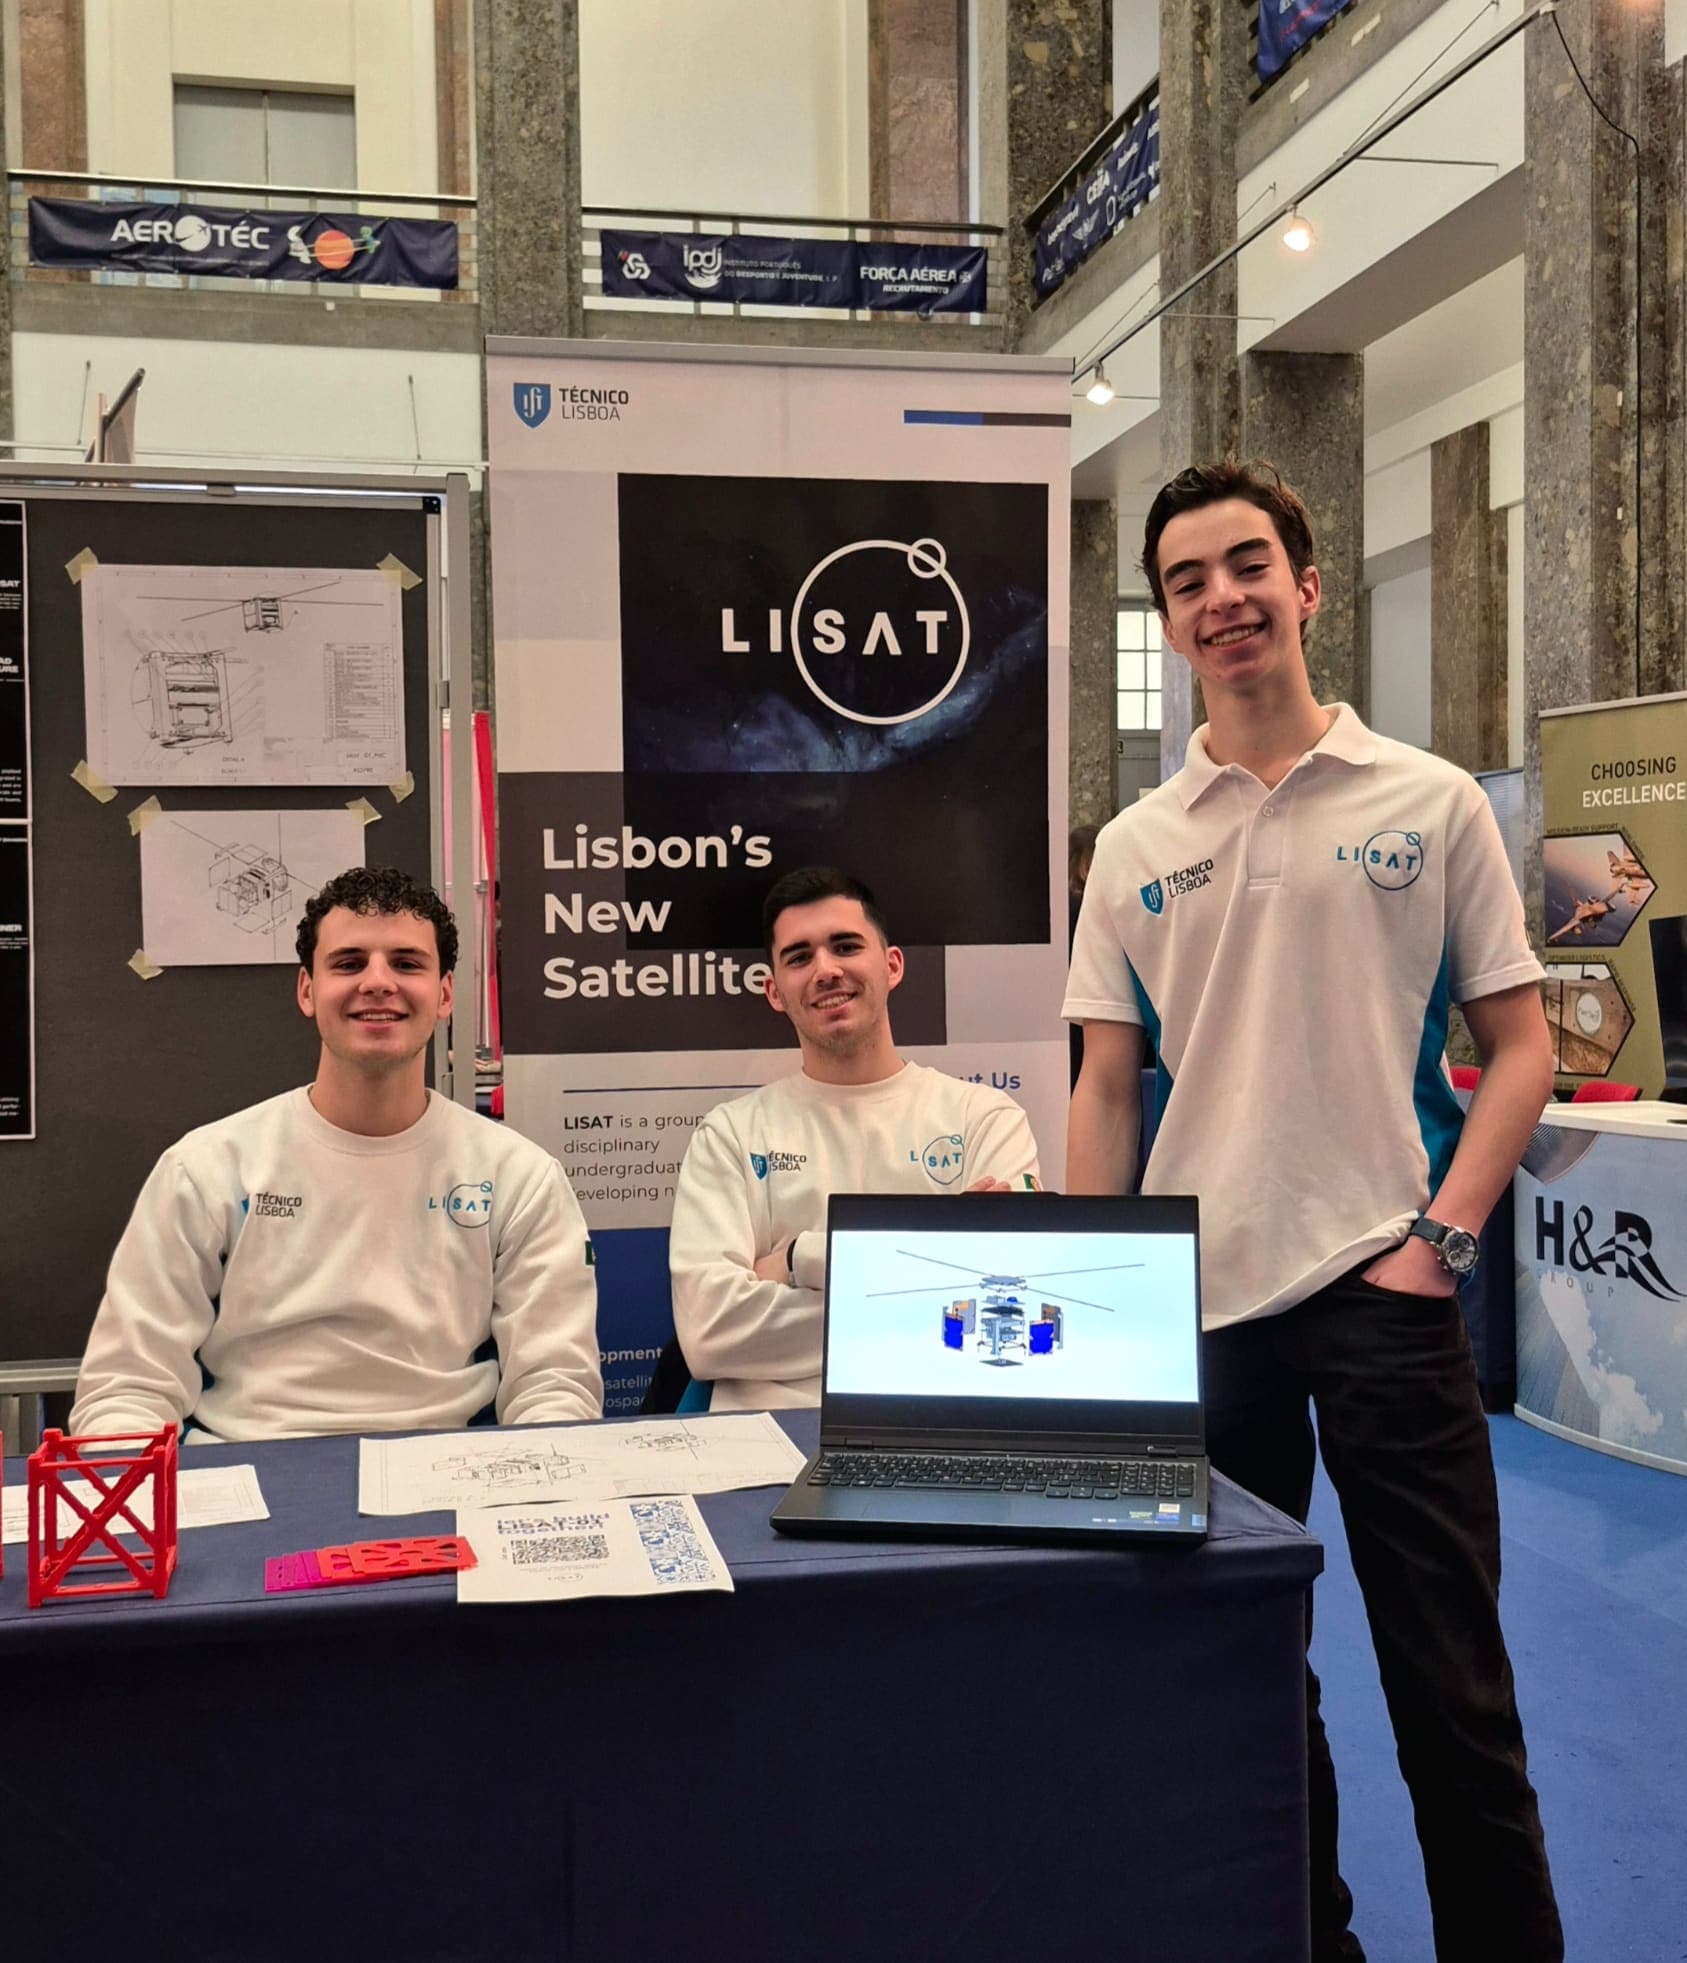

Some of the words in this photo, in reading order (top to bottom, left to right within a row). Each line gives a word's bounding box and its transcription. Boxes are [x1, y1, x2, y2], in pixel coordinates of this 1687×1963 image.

[860, 266, 908, 283] FORÇA
[910, 266, 957, 282] AÉREA
[883, 284, 949, 294] RECRUTAMENTO
[559, 385, 629, 404] TÉCNICO
[562, 405, 621, 421] LISBOA
[721, 607, 948, 656] LISAT
[1591, 756, 1677, 780] CHOOSING
[1582, 781, 1687, 808] EXCELLENCE
[1336, 846, 1418, 872] LISAT
[1164, 858, 1214, 887] TÉCNICO
[1168, 876, 1212, 898] LISBOA
[544, 893, 672, 934] New
[543, 951, 770, 999] Satellite
[992, 1072, 1021, 1090] Us
[564, 1116, 613, 1130] LISAT
[620, 1115, 633, 1128] is
[639, 1117, 648, 1128] a
[564, 1139, 660, 1155] disciplinary
[769, 1160, 801, 1172] ISBOA
[910, 1150, 962, 1168] LSAT
[565, 1160, 682, 1179] undergraduat
[255, 1192, 302, 1207] TÉCNICO
[574, 1186, 659, 1201] eveloping
[255, 1205, 295, 1218] LISBOA
[429, 1196, 491, 1212] LISAT
[1535, 1196, 1687, 1302] H&R
[600, 1347, 663, 1364] opment
[605, 1376, 652, 1390] satellit
